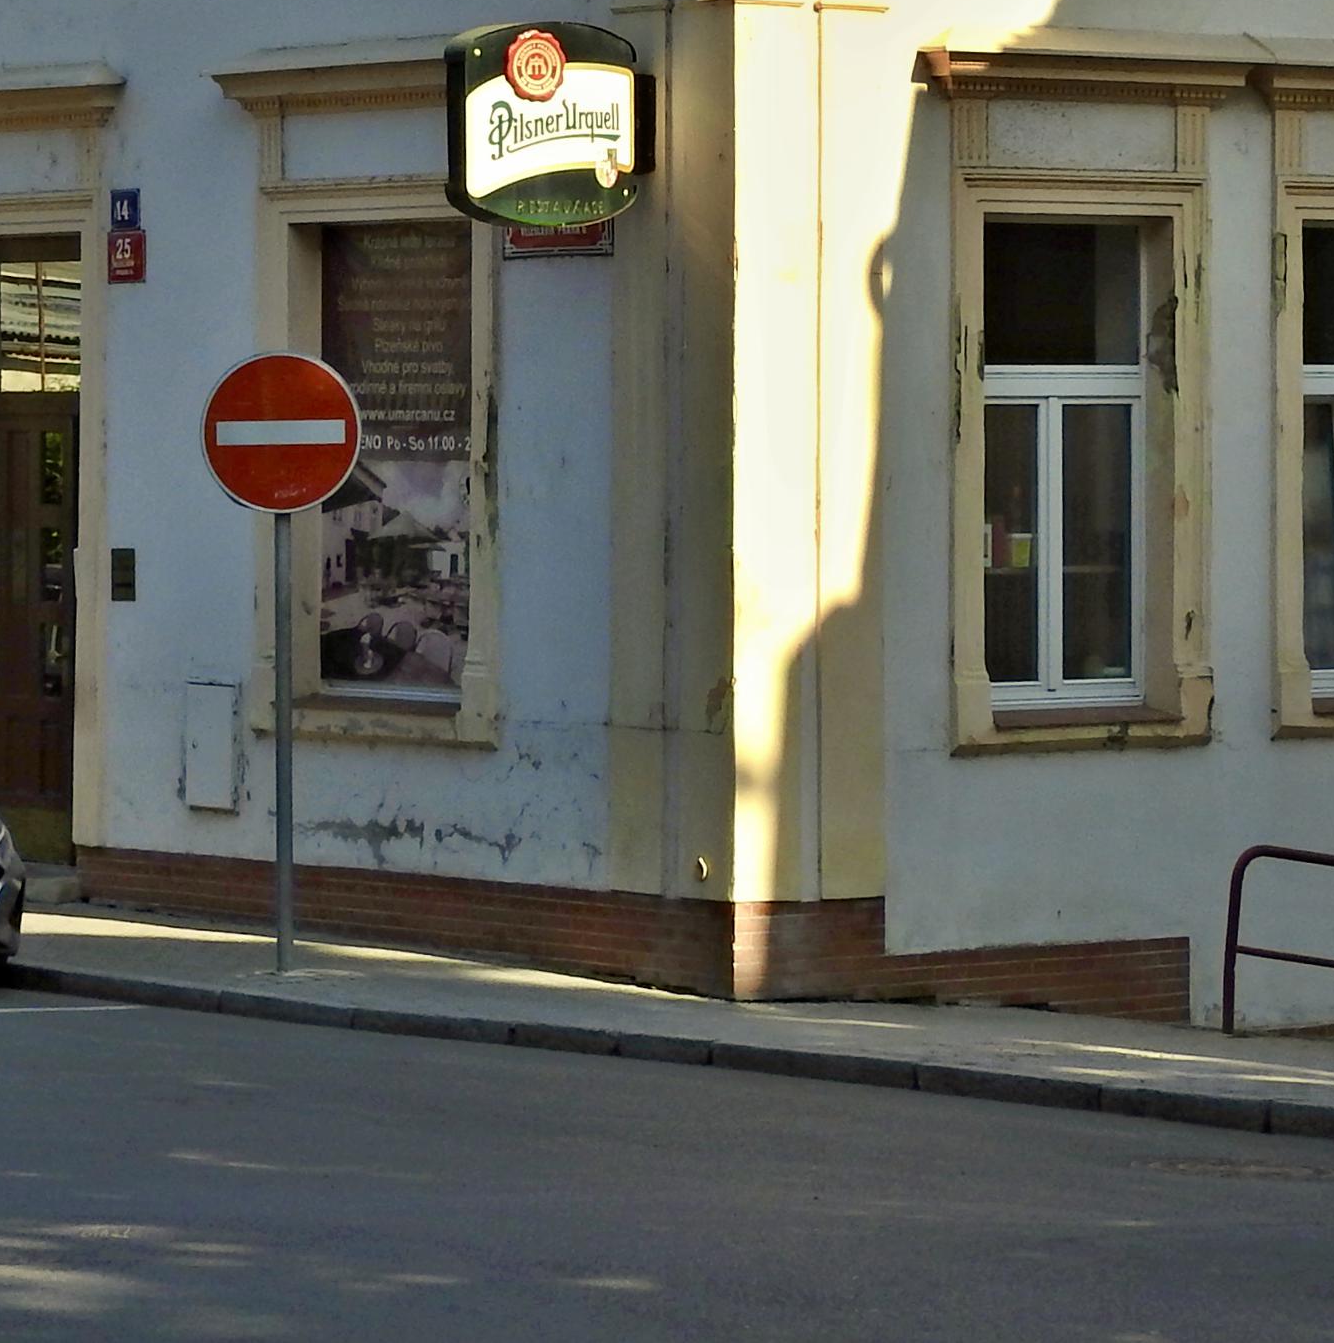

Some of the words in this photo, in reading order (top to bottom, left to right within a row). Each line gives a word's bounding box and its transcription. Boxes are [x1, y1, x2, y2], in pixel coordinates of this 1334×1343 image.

[488, 100, 563, 161] Pilsner
[561, 98, 620, 143] Urquell
[115, 199, 129, 221] 14
[115, 238, 131, 259] 25
[402, 362, 420, 376] pro
[386, 435, 401, 450] Po
[409, 435, 425, 450] So
